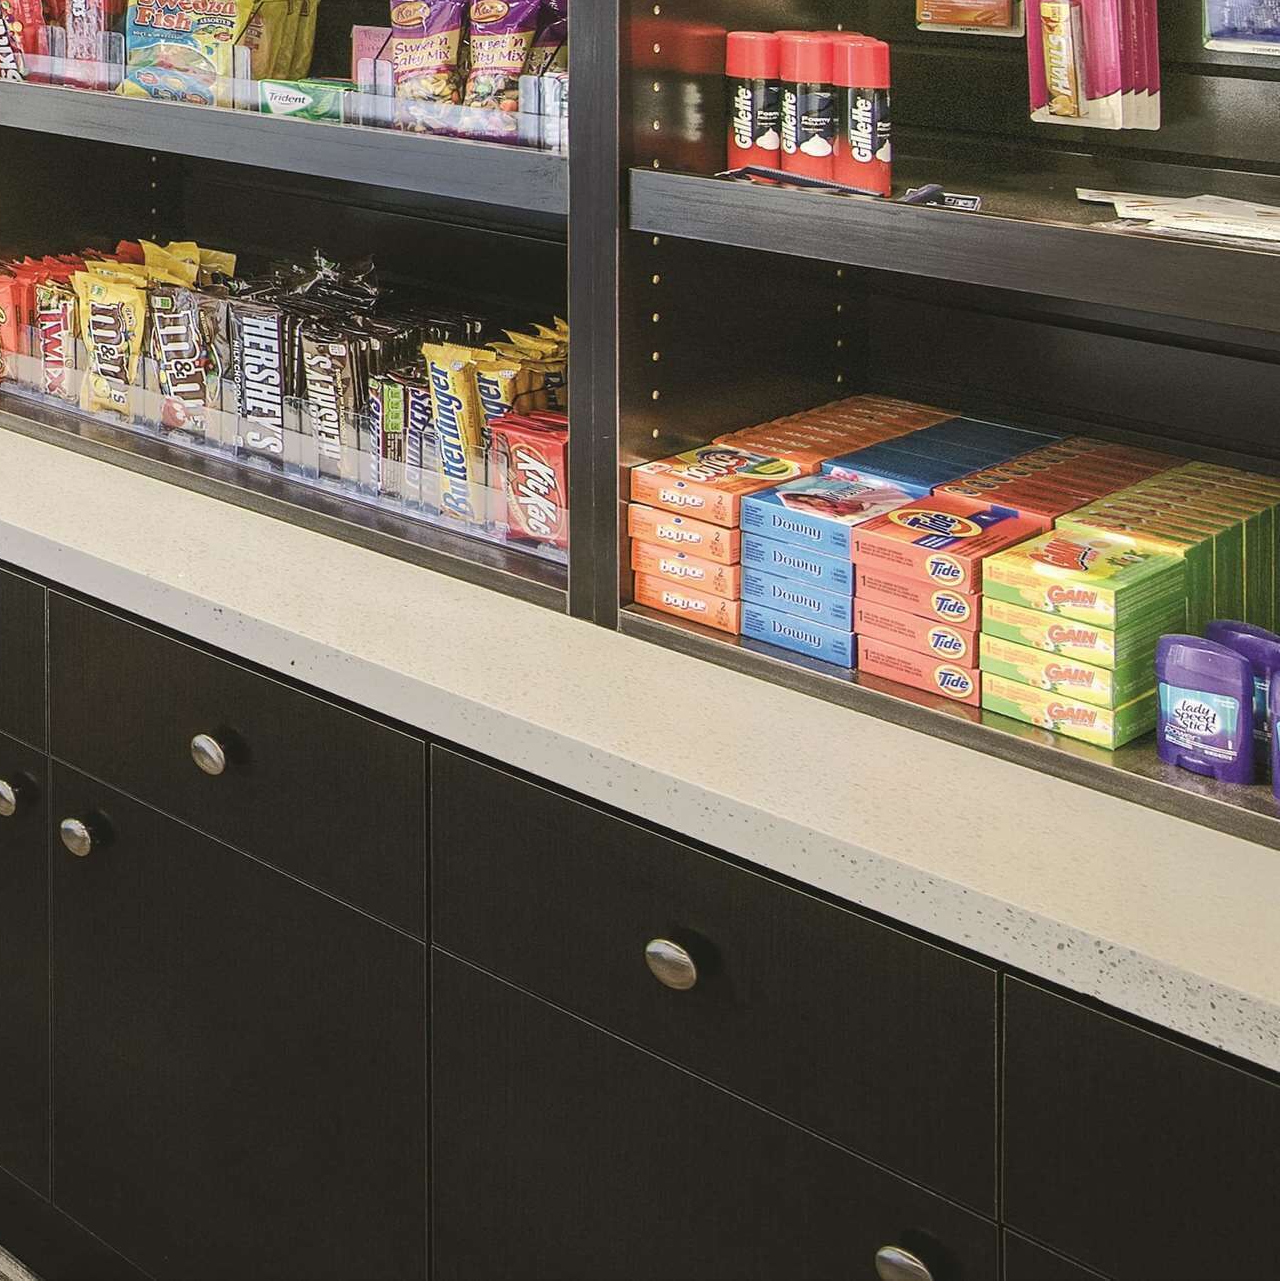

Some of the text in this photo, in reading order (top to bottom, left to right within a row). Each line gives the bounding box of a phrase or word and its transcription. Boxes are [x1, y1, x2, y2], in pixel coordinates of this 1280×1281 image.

[134, 7, 193, 32] Fish
[197, 16, 235, 28] ASSORTED
[394, 35, 449, 55] Sweet 'n
[427, 48, 450, 62] Mix
[497, 49, 525, 63] Mix
[1048, 35, 1072, 97] HALLS
[267, 91, 306, 105] Trident
[734, 85, 754, 150] Gillette
[781, 89, 798, 155] Gillette
[801, 115, 831, 125] Foamy
[850, 97, 873, 164] Gillette
[40, 303, 68, 395] TWIX
[242, 315, 283, 455] HERSHEY'S
[429, 361, 471, 516] Butterfinger
[658, 490, 705, 508] bounce
[656, 525, 702, 544] bounce
[772, 514, 823, 540] Downy
[907, 512, 960, 537] Tide
[659, 560, 705, 579] bounce
[772, 550, 823, 577] Downy
[930, 560, 961, 578] Tide
[662, 592, 707, 612] bounce
[772, 584, 823, 612] Downy
[935, 596, 966, 615] Tide
[772, 620, 823, 648] Downy
[932, 632, 962, 652] Tide
[939, 670, 970, 690] Tide
[1173, 708, 1217, 724] Speed
[1182, 720, 1215, 734] Stick
